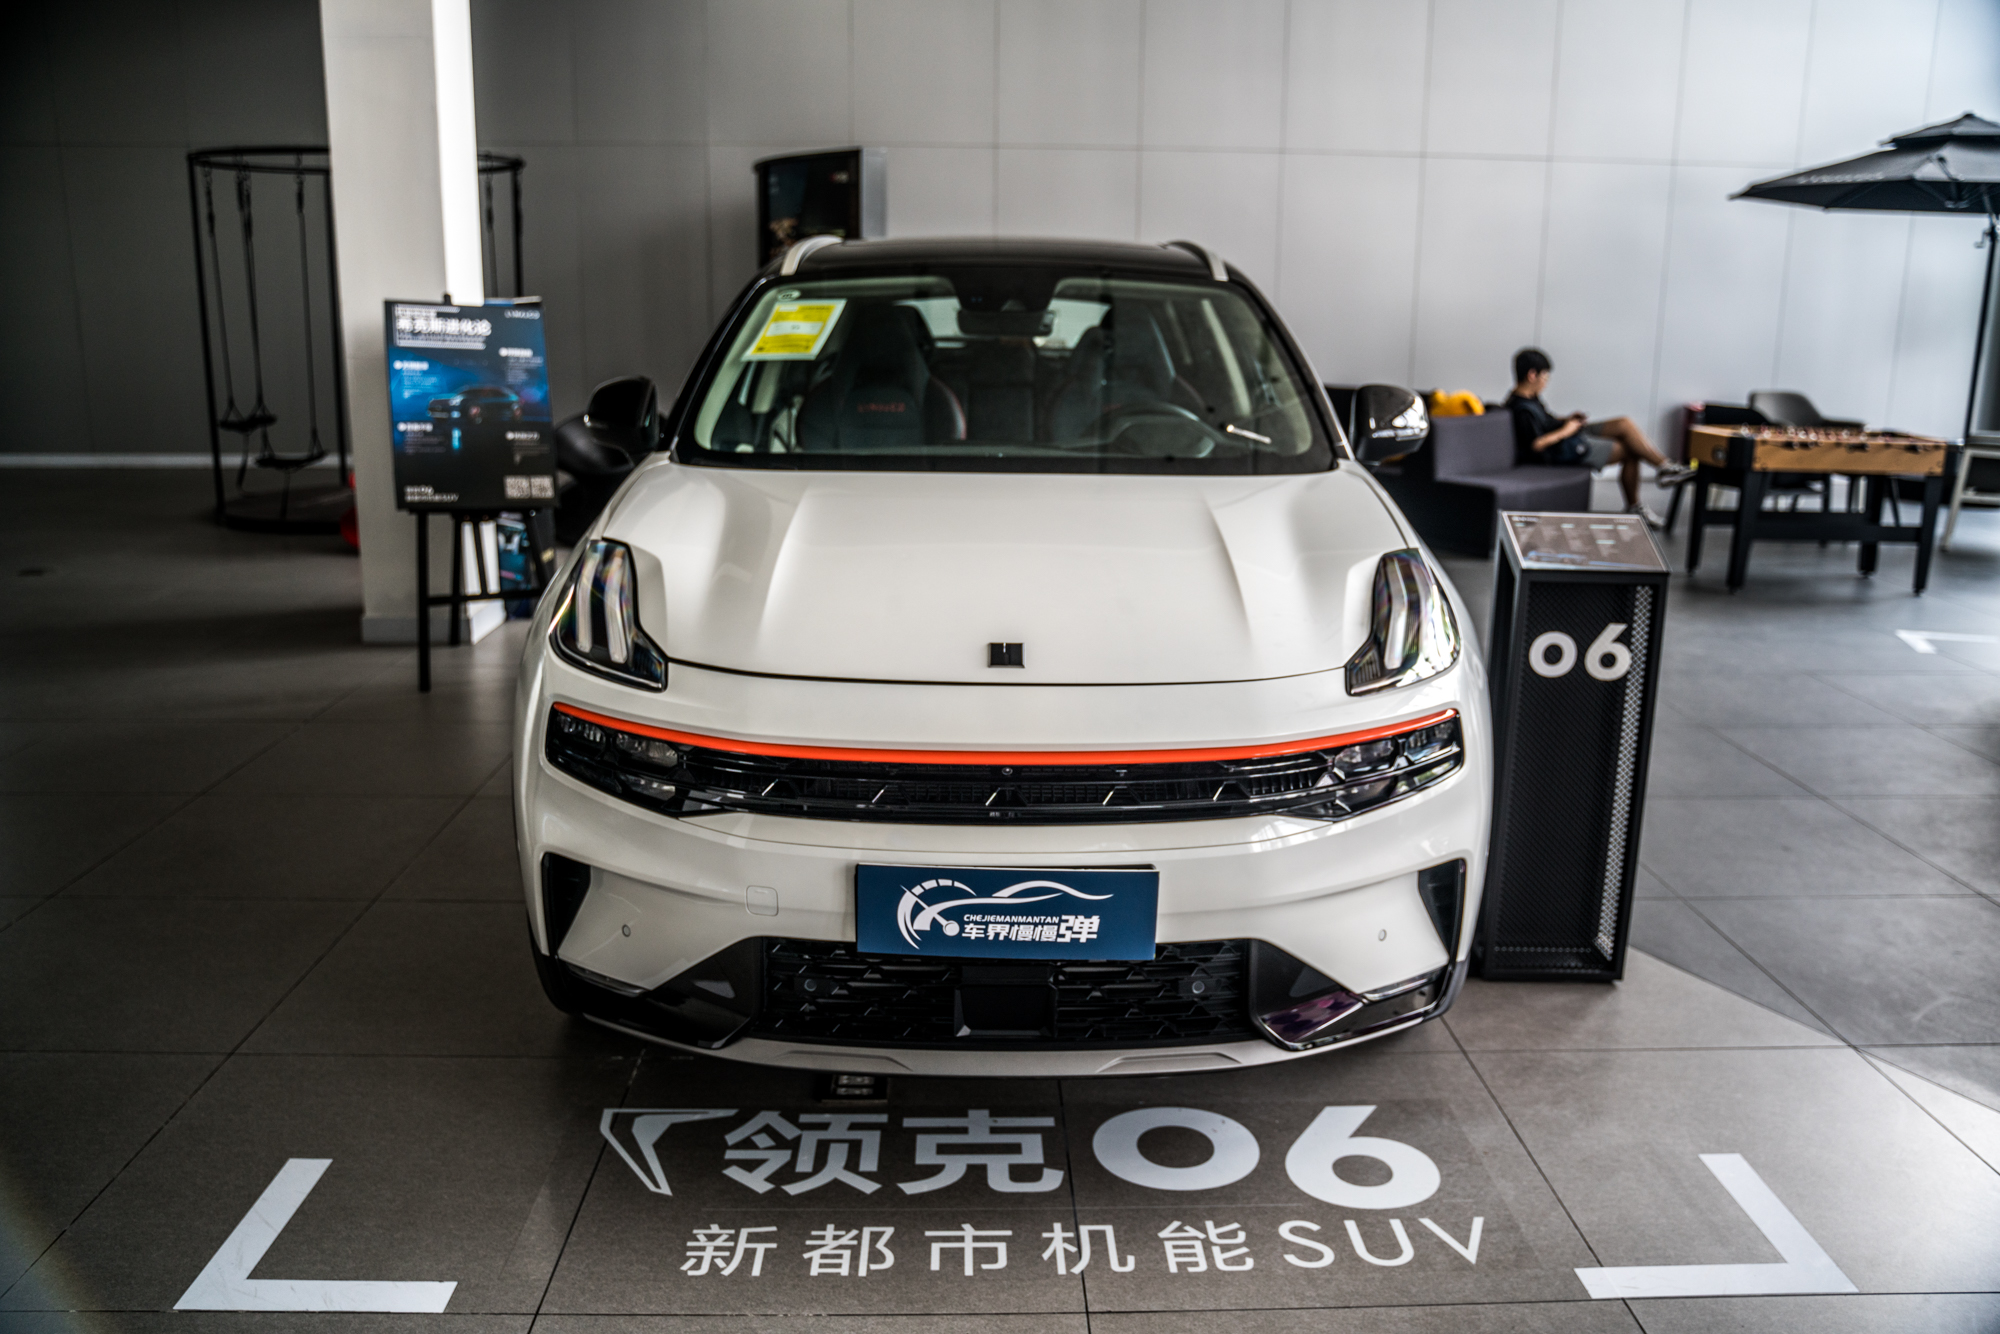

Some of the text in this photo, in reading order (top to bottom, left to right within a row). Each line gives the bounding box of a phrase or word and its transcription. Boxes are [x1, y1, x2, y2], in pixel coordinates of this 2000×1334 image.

[1528, 622, 1632, 681] 06
[961, 914, 1101, 943] 车界慢慢弹
[963, 913, 1059, 924] CHEJIEMANMANTAN
[722, 1104, 1441, 1210] 领克06
